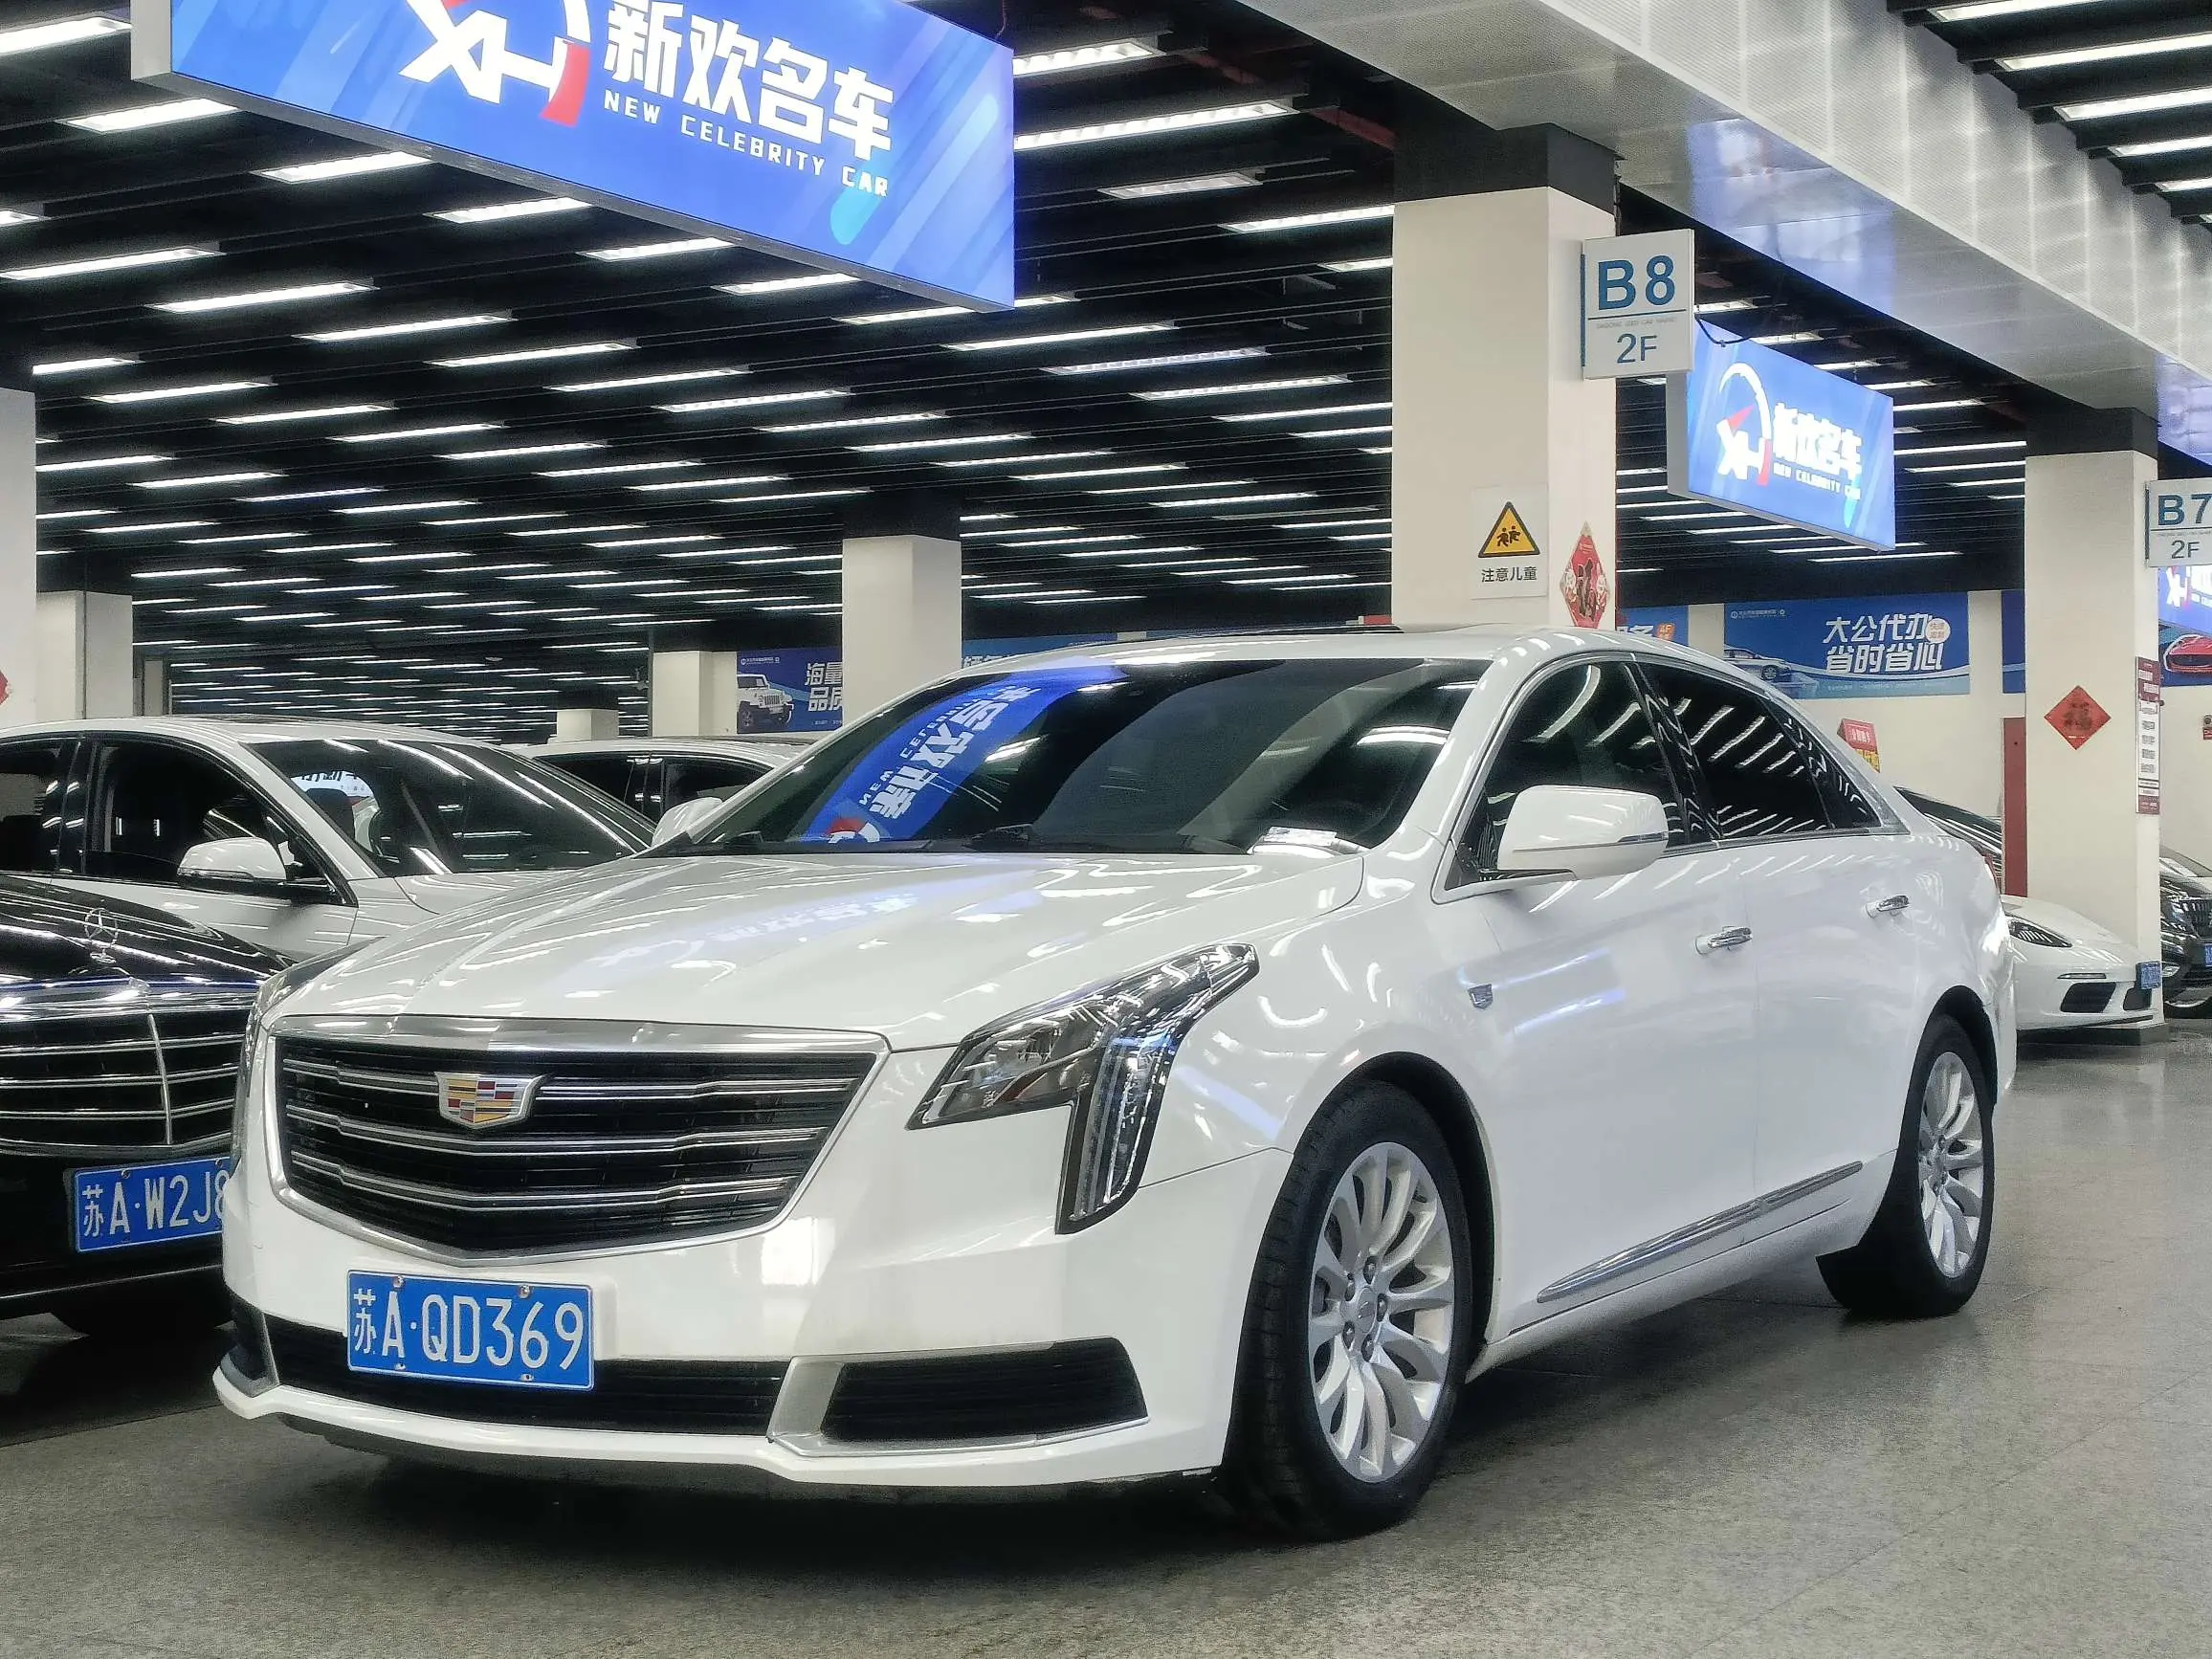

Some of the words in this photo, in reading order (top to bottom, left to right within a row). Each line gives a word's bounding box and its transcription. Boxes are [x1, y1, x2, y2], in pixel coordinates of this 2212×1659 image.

[603, 0, 895, 161] 新欢名车
[604, 89, 661, 124] NEW
[680, 113, 826, 176] CELEBRITY
[841, 165, 889, 197] CAR
[1598, 254, 1675, 310] B8
[1616, 333, 1658, 364] 2F
[2158, 493, 2212, 525] B7
[2171, 540, 2201, 559] 2F
[1481, 566, 1537, 583] 注意儿童
[1823, 612, 1933, 644] 大公代办
[805, 661, 842, 686] 海量
[1825, 641, 1944, 674] 省时省心
[353, 1287, 585, 1371] 苏A·QD369
